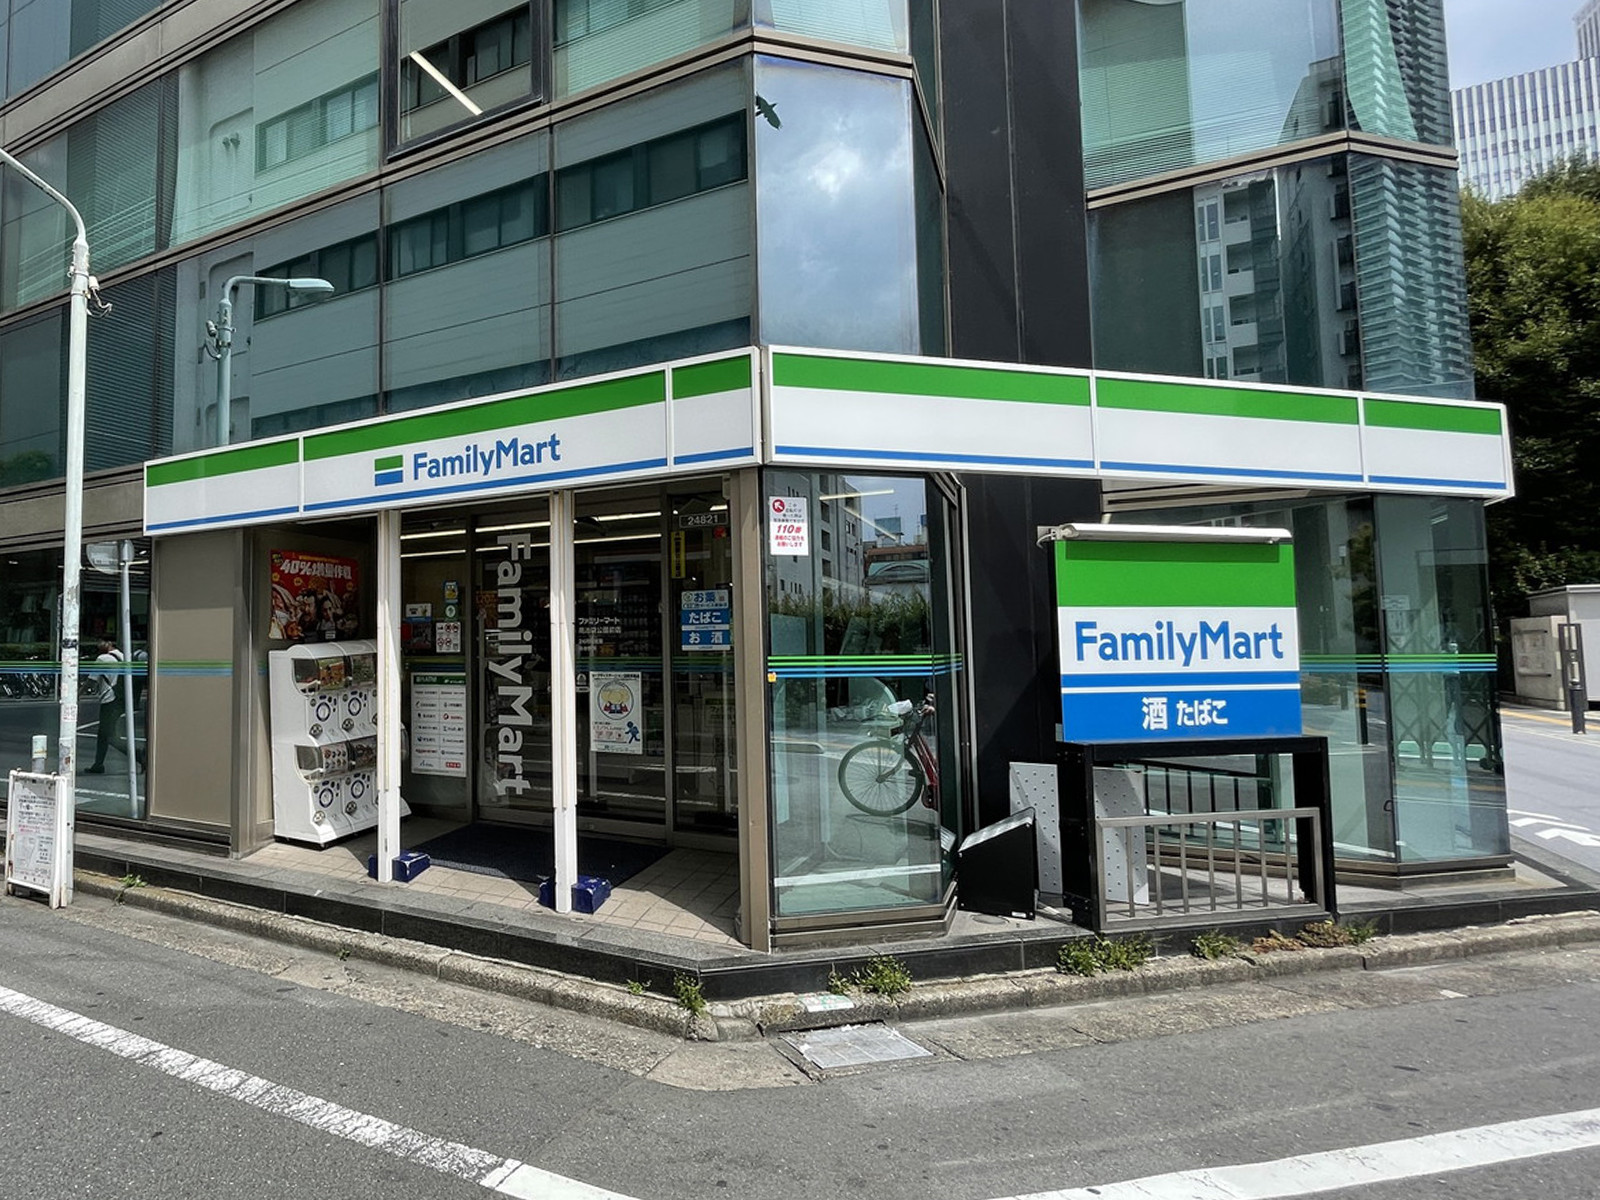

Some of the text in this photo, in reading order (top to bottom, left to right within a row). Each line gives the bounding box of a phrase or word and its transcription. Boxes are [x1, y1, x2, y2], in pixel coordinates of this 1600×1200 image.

[414, 433, 561, 481] FamilyMart
[688, 515, 718, 526] 24821
[688, 611, 722, 624] たばこ
[1075, 620, 1283, 667] FamilyMart
[488, 533, 533, 796] FamilyMart
[1141, 697, 1229, 731] 酒 たばこ
